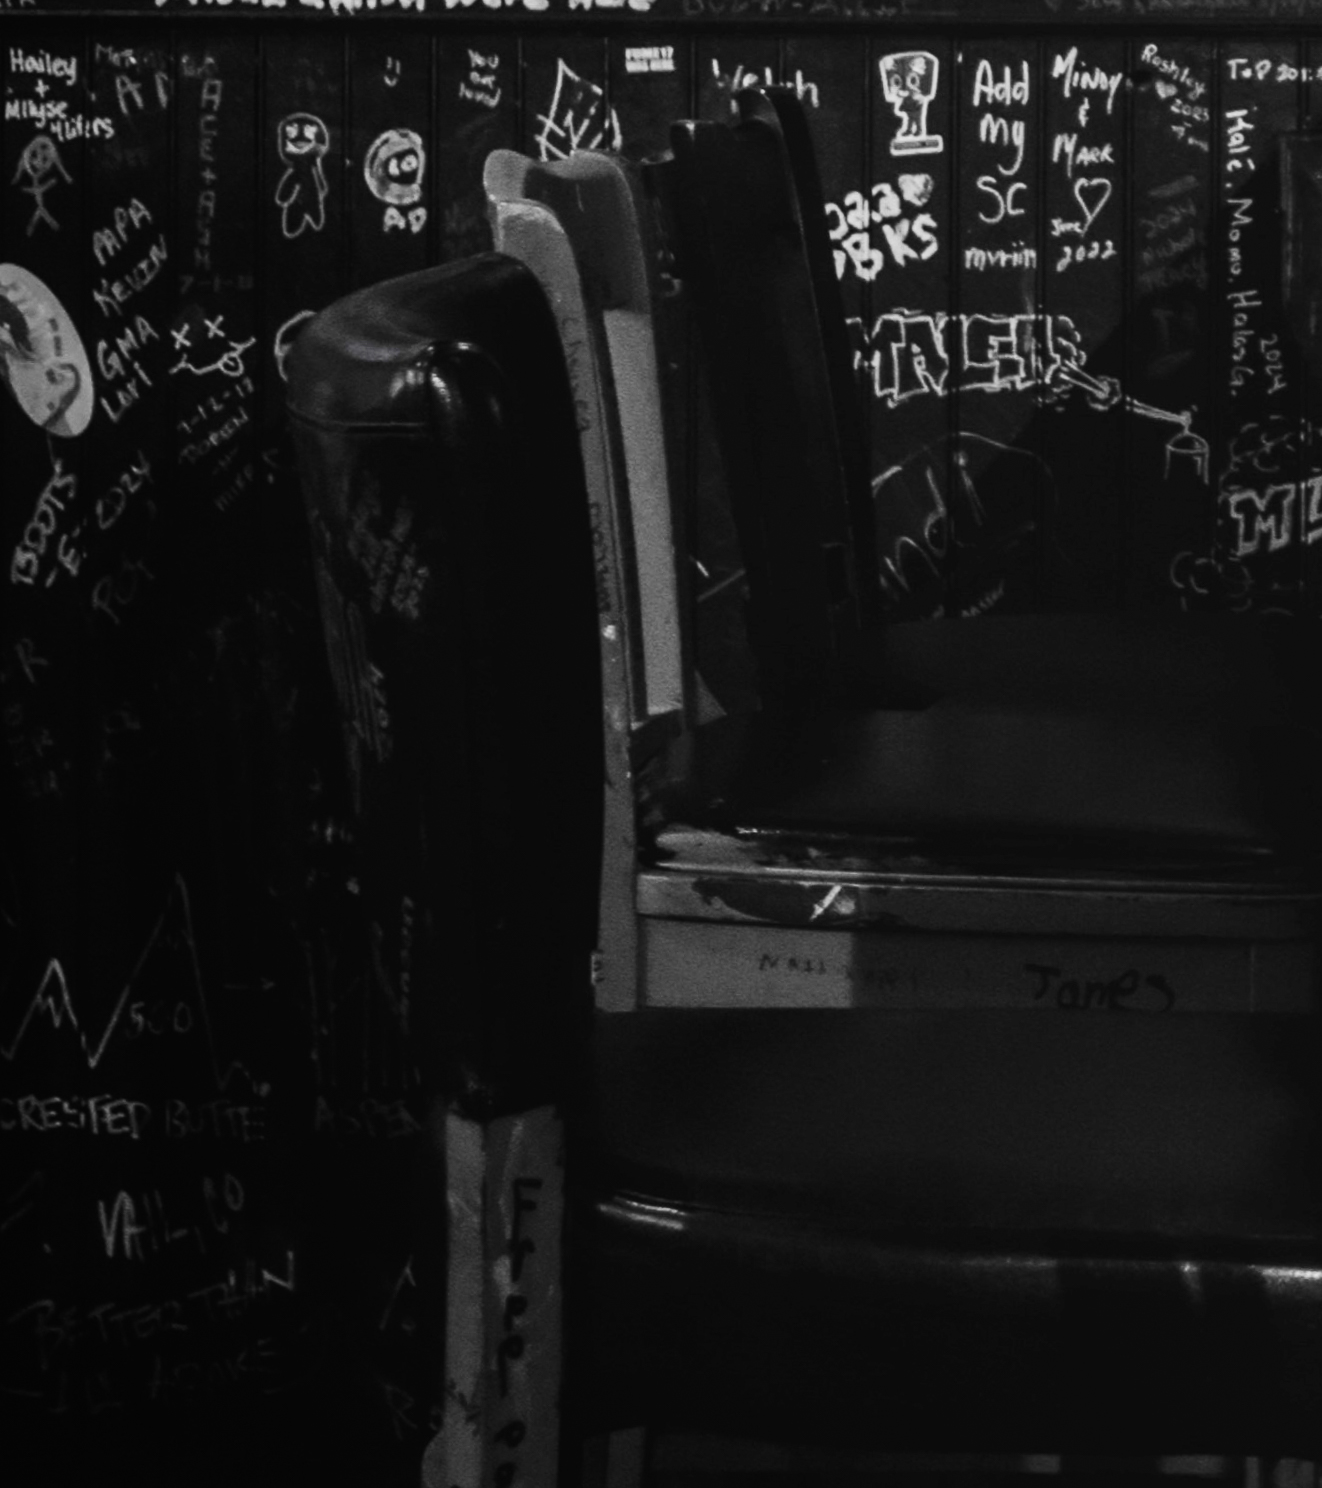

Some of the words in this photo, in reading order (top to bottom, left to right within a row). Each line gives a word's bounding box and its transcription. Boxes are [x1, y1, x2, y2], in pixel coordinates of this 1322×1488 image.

[9, 48, 79, 83] Hailey
[971, 58, 1032, 107] Add
[91, 196, 154, 265] PAPA
[95, 315, 161, 380] GMA
